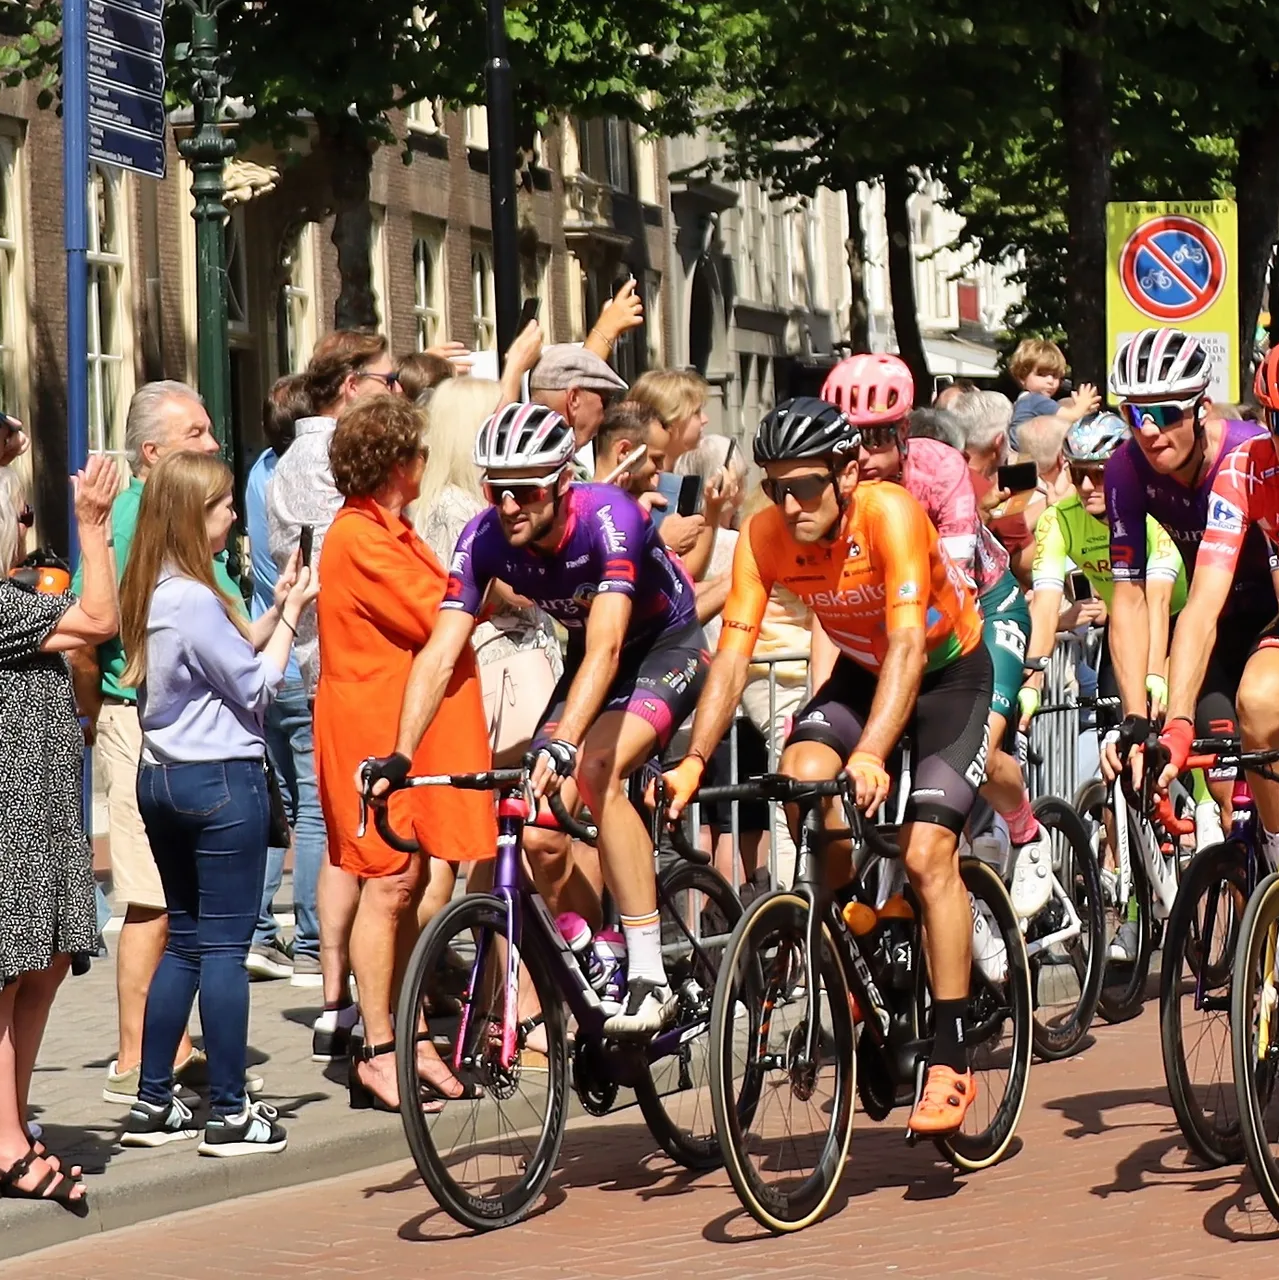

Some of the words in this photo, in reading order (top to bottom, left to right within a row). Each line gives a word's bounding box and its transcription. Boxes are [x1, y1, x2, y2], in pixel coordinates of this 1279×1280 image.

[1166, 203, 1180, 214] La
[1185, 202, 1229, 214] Vuelta
[800, 583, 885, 608] uskalt
